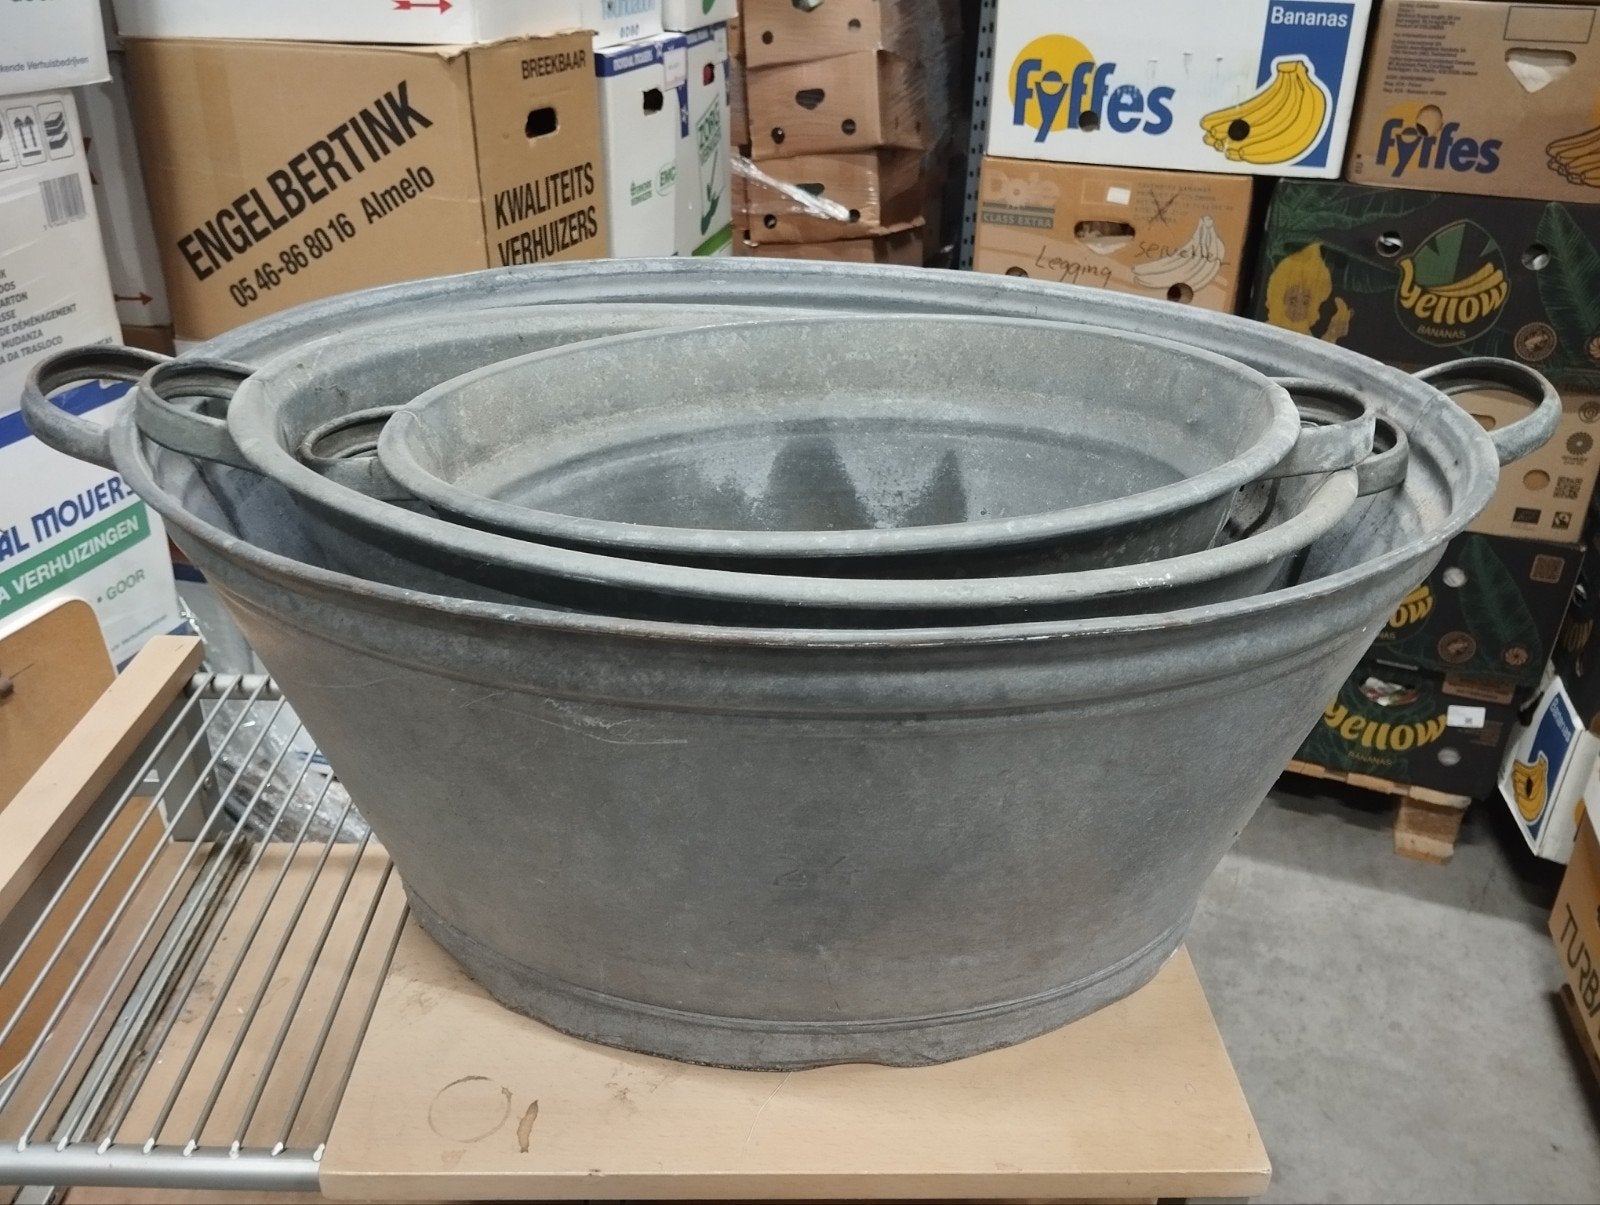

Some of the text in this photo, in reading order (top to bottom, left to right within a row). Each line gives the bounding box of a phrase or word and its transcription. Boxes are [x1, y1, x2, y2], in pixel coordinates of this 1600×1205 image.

[1270, 6, 1348, 28] Bananas
[521, 50, 586, 80] BREEKBAAR
[177, 80, 433, 281] ENGELBERTINK
[360, 165, 435, 224] Almelo
[495, 162, 594, 230] KWALITEITS
[498, 205, 598, 267] VERHUIZERS
[2, 329, 43, 349] MUDANZA
[21, 335, 63, 356] TRASLOCO
[1417, 324, 1467, 339] BANANAS
[31, 475, 134, 543] MOVER
[12, 515, 140, 595] VERHUIZINGEN
[106, 569, 147, 600] GOOR
[1324, 697, 1447, 750] yellow
[1349, 751, 1392, 766] BANANAS
